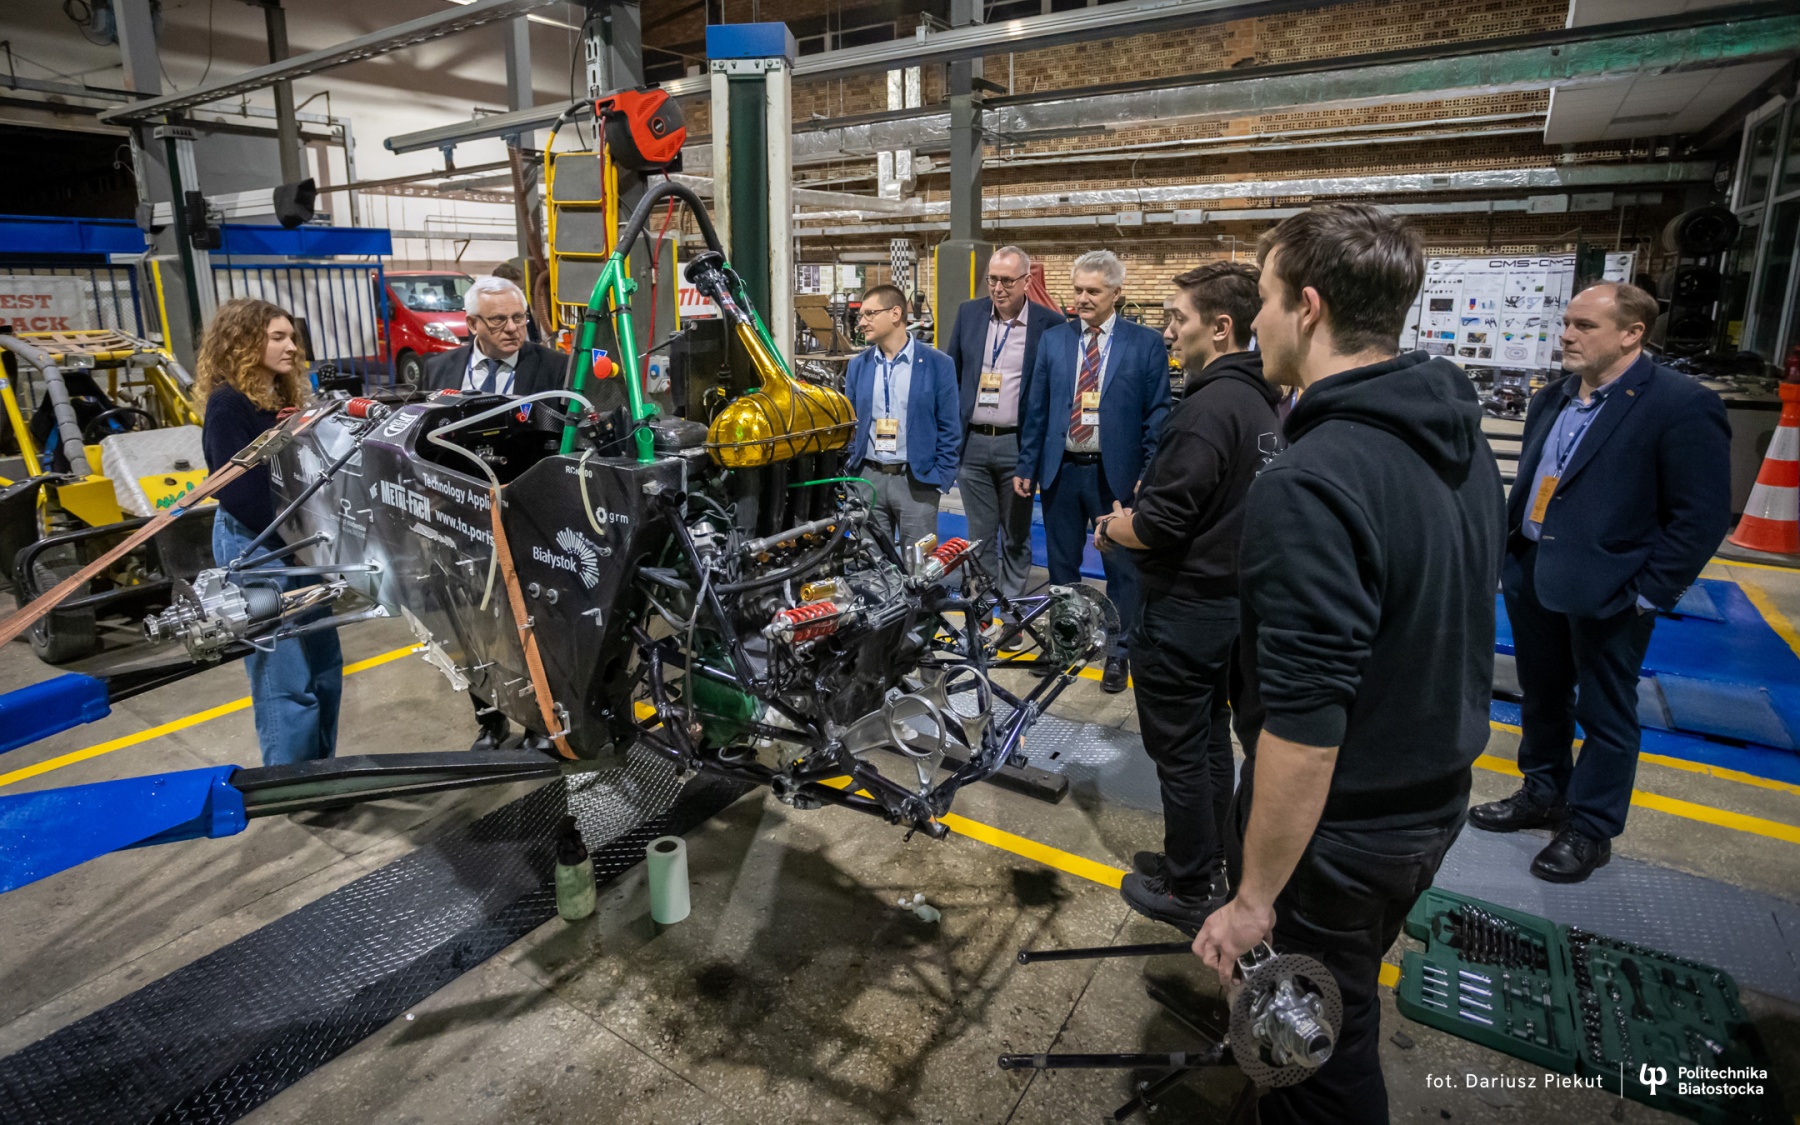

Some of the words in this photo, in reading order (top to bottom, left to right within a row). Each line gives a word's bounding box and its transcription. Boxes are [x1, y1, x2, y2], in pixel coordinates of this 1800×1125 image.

[0, 316, 70, 331] ACK
[422, 473, 466, 505] Technology
[467, 488, 493, 511] Appli
[435, 509, 495, 547] www.ta.parts
[609, 512, 629, 524] grm
[532, 546, 577, 573] Białystok
